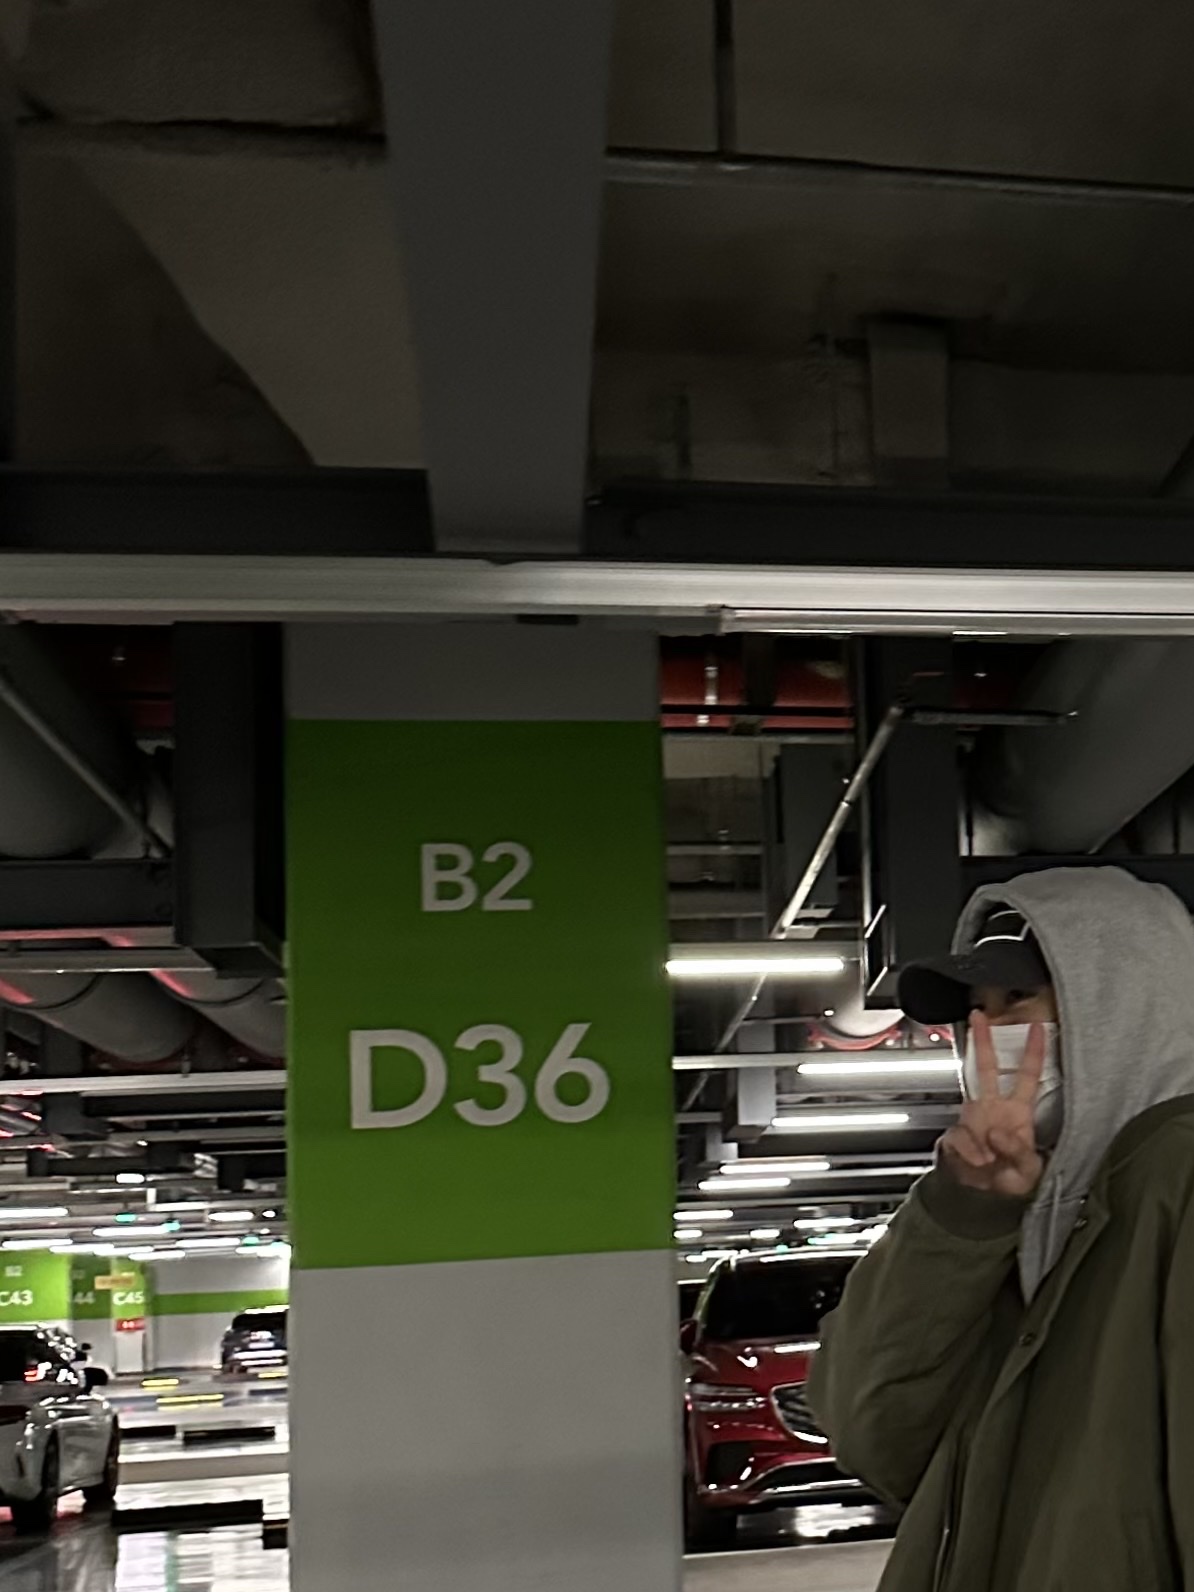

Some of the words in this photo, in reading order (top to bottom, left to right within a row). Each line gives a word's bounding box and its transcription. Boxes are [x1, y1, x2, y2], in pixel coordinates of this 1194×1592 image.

[421, 841, 533, 912] B2
[349, 1022, 611, 1129] D36
[0, 1290, 34, 1306] C43
[73, 1291, 95, 1304] 44
[112, 1291, 145, 1305] C45
